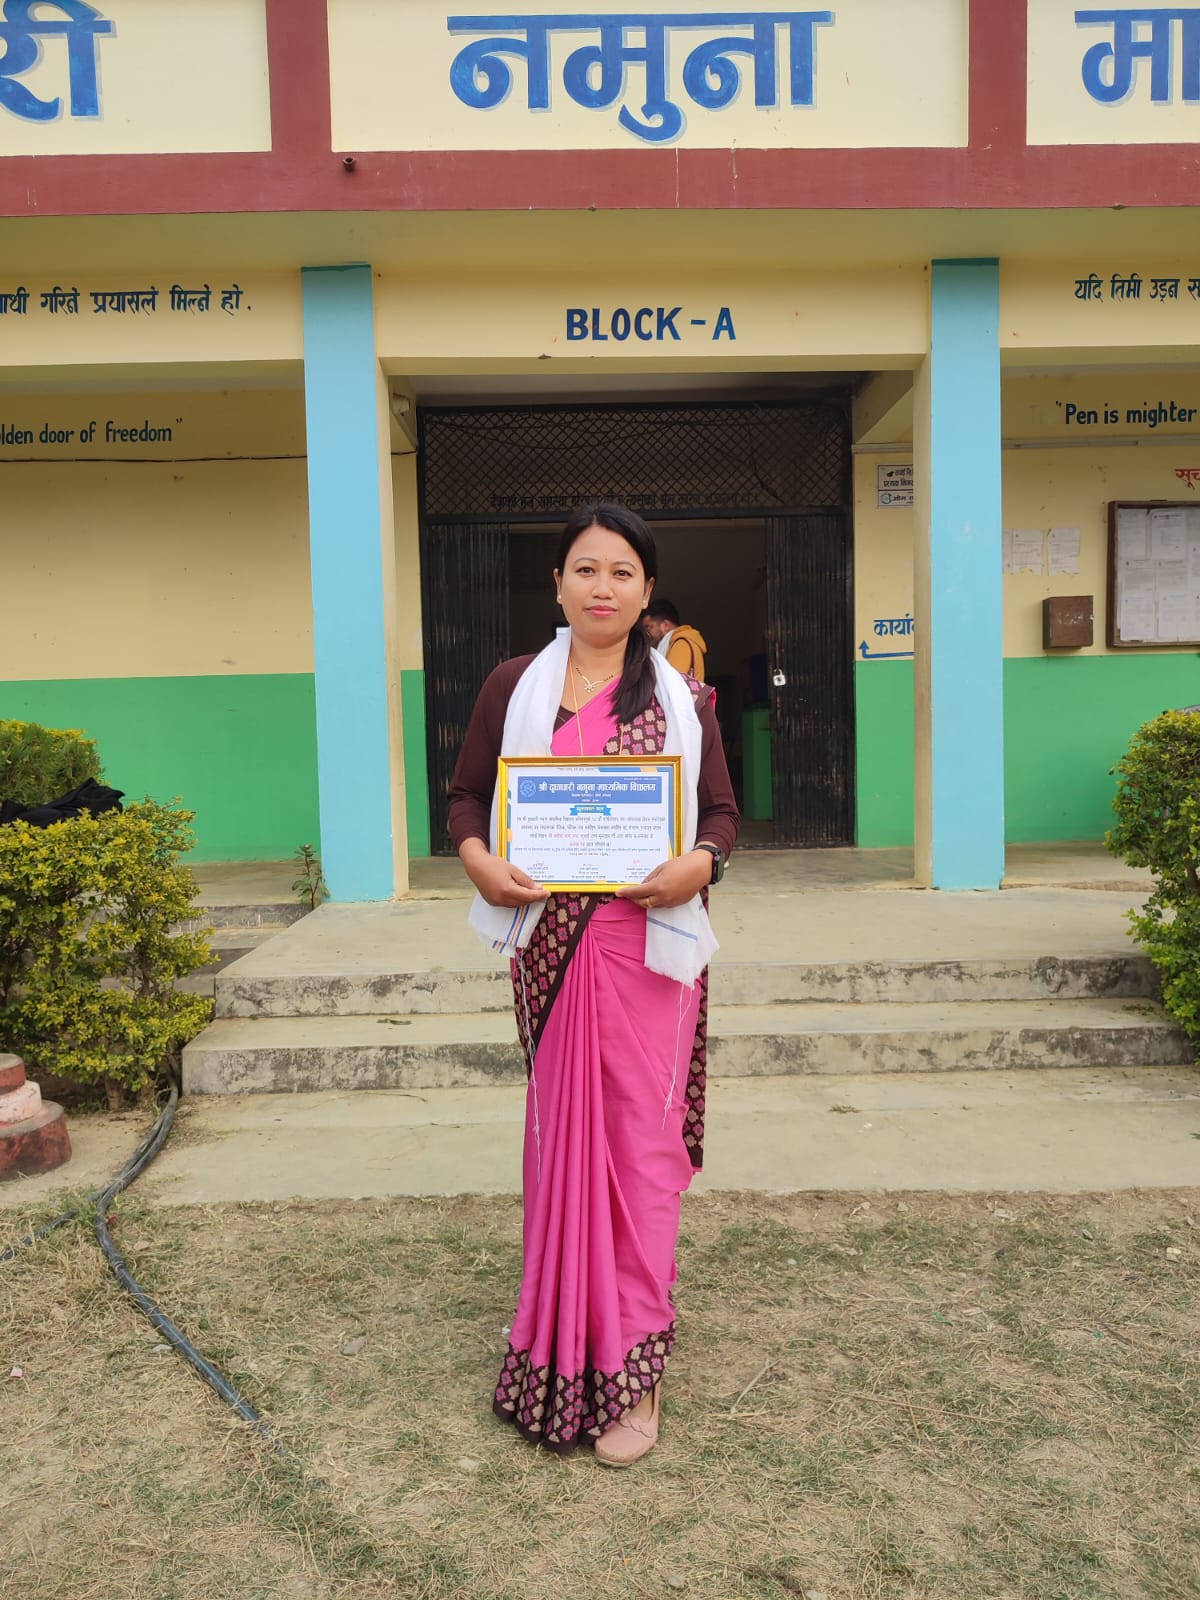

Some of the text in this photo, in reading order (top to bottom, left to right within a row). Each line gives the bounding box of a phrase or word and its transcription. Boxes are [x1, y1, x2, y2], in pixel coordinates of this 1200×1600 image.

[446, 11, 834, 143] नमुना
[1074, 273, 1103, 302] यदि
[1110, 273, 1142, 302] तिमी
[1104, 403, 1119, 424] is
[1126, 400, 1198, 428] mighter
[39, 422, 75, 444] door
[80, 421, 97, 443] of
